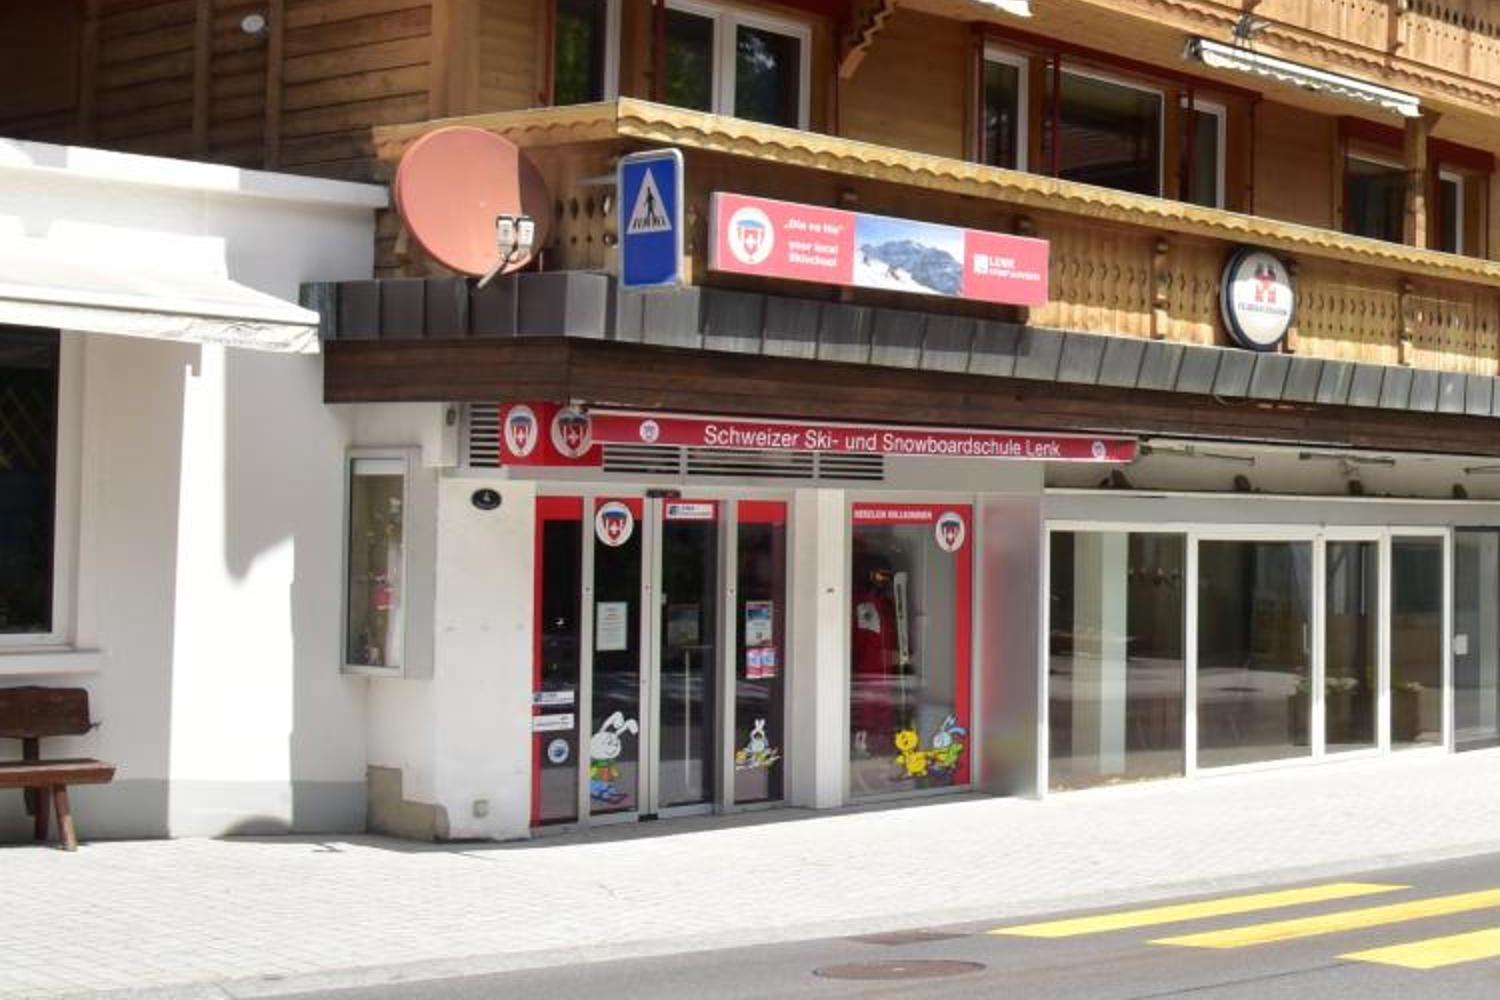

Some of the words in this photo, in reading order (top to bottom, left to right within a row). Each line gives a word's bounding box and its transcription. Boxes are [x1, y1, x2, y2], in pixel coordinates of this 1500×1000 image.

[704, 425, 799, 447] Schweizer
[804, 428, 839, 449] Ski-
[845, 433, 877, 450] und
[883, 433, 1021, 456] Snowboardschule
[1025, 439, 1061, 457] Lenk
